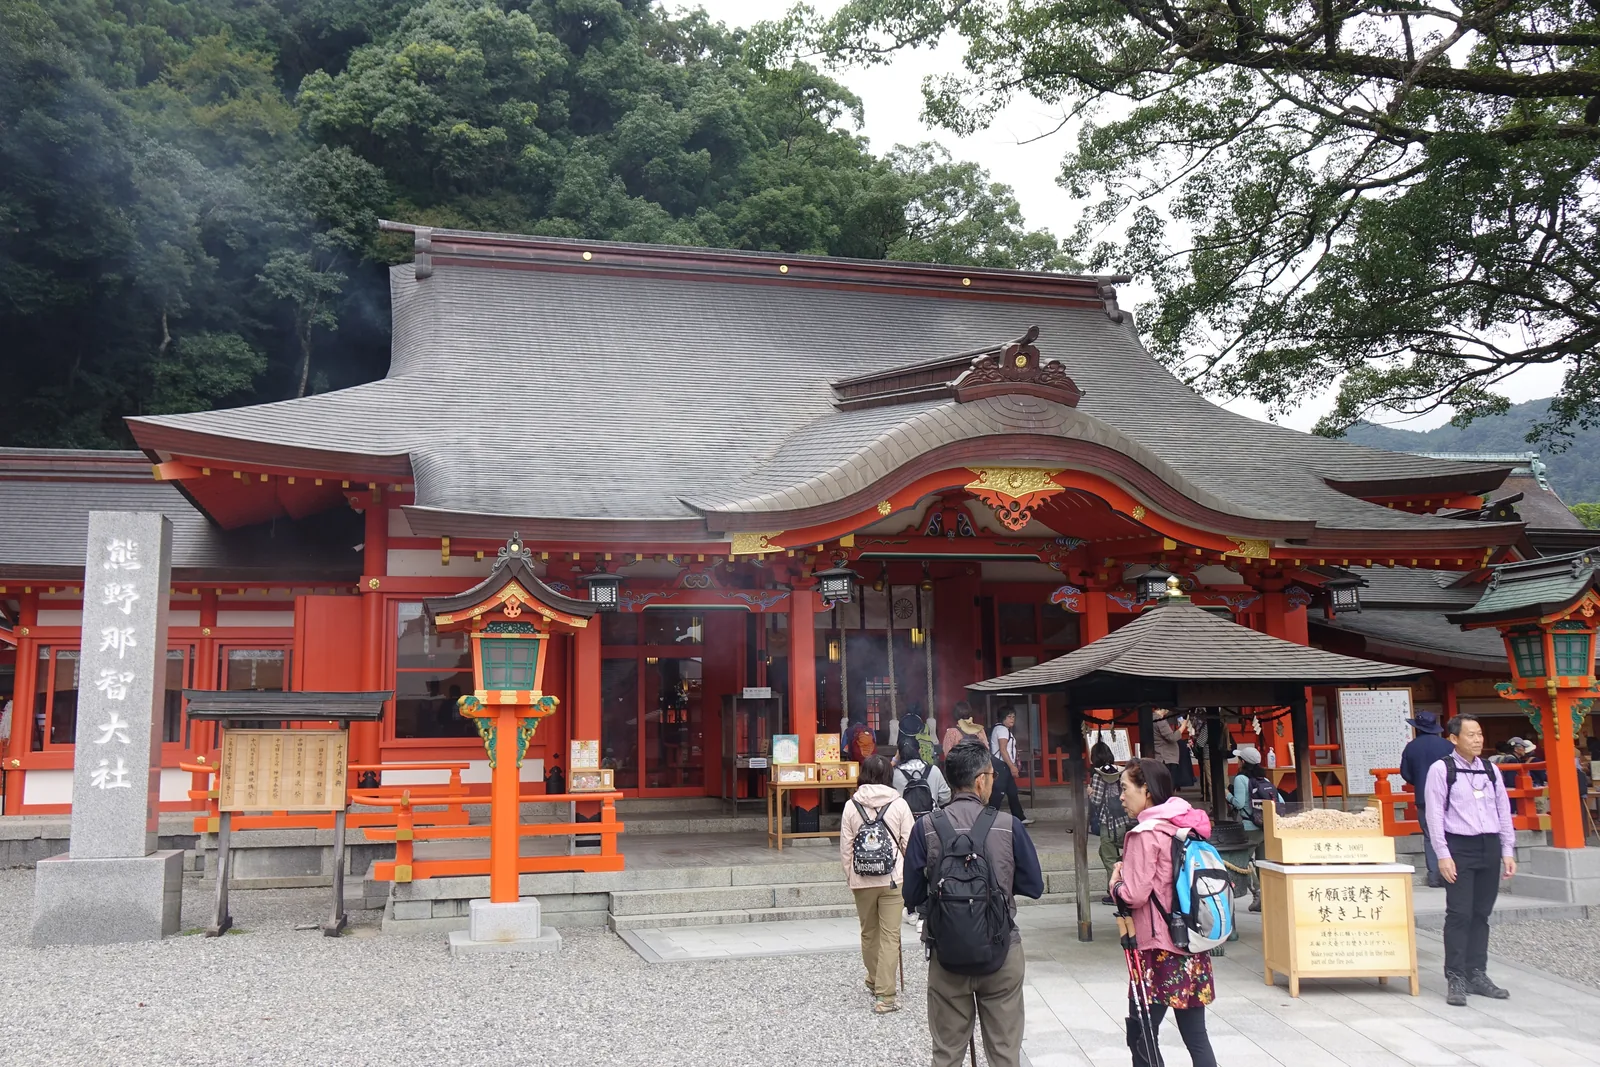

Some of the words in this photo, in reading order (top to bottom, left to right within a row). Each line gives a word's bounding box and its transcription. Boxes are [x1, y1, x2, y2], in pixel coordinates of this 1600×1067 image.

[90, 538, 141, 790] 熊野那智大社
[1313, 842, 1343, 852] 護摩木
[855, 862, 885, 871] MOSCHINO
[1308, 885, 1391, 903] 祈願護摩木
[1318, 905, 1384, 923] 焚き上げ
